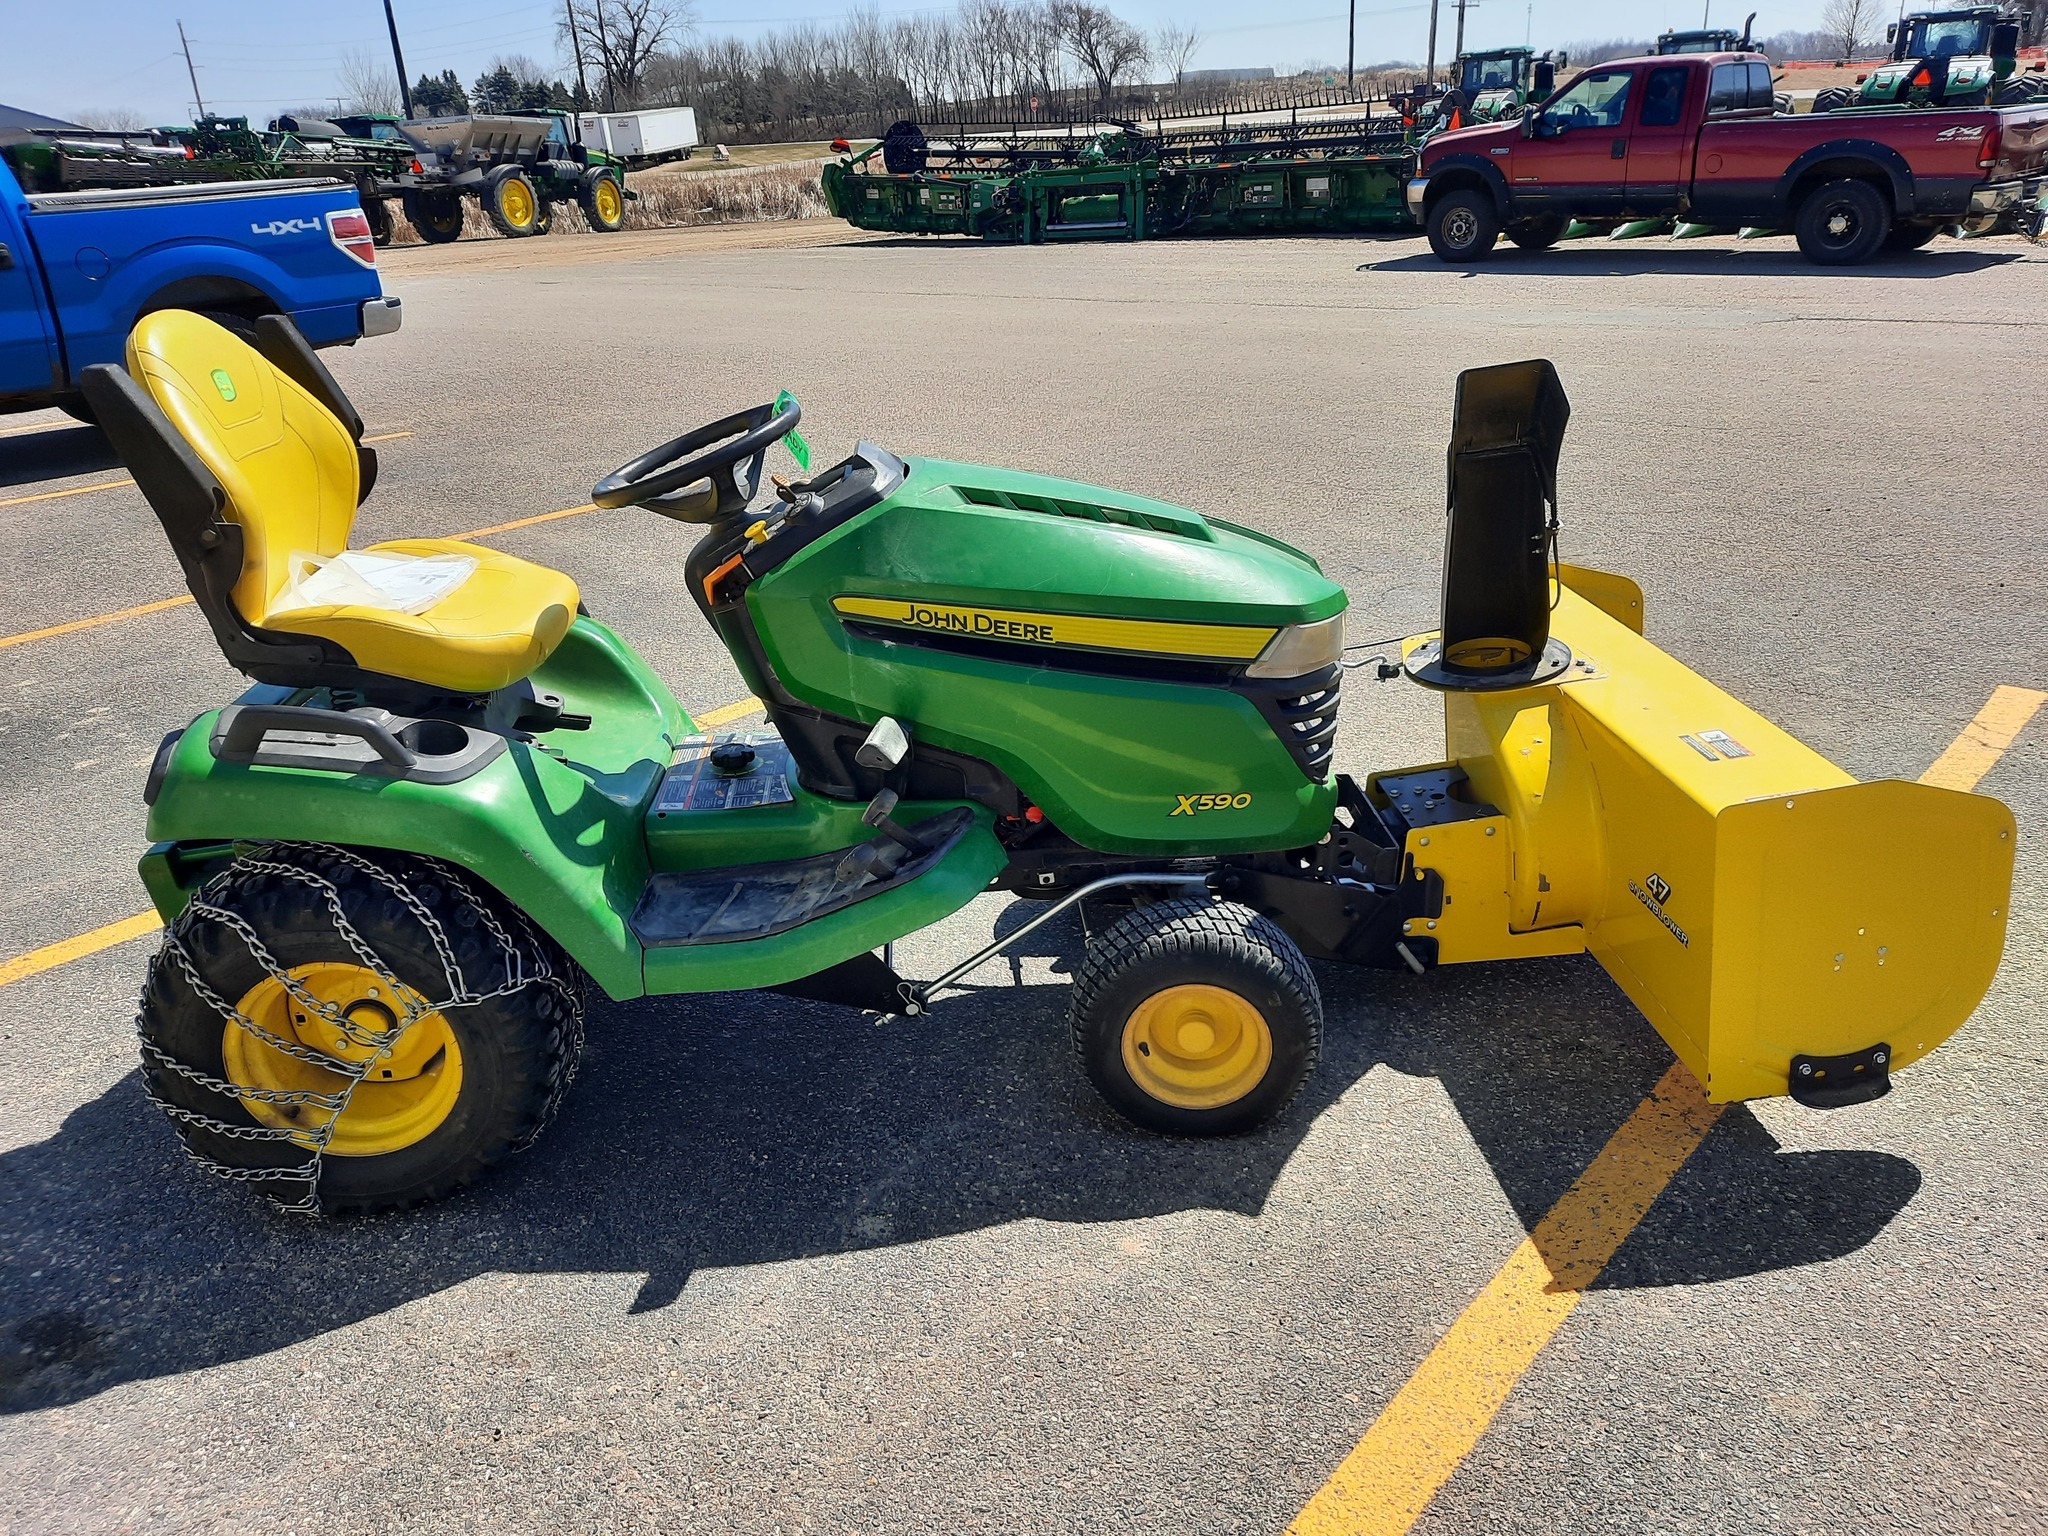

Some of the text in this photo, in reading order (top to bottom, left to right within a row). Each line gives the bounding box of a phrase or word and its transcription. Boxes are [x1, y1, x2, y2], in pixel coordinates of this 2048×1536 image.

[901, 604, 1055, 642] JOHN DEERE
[1167, 792, 1253, 816] X590
[1646, 873, 1671, 906] 47
[1628, 879, 1688, 949] SNOWBLOWER
